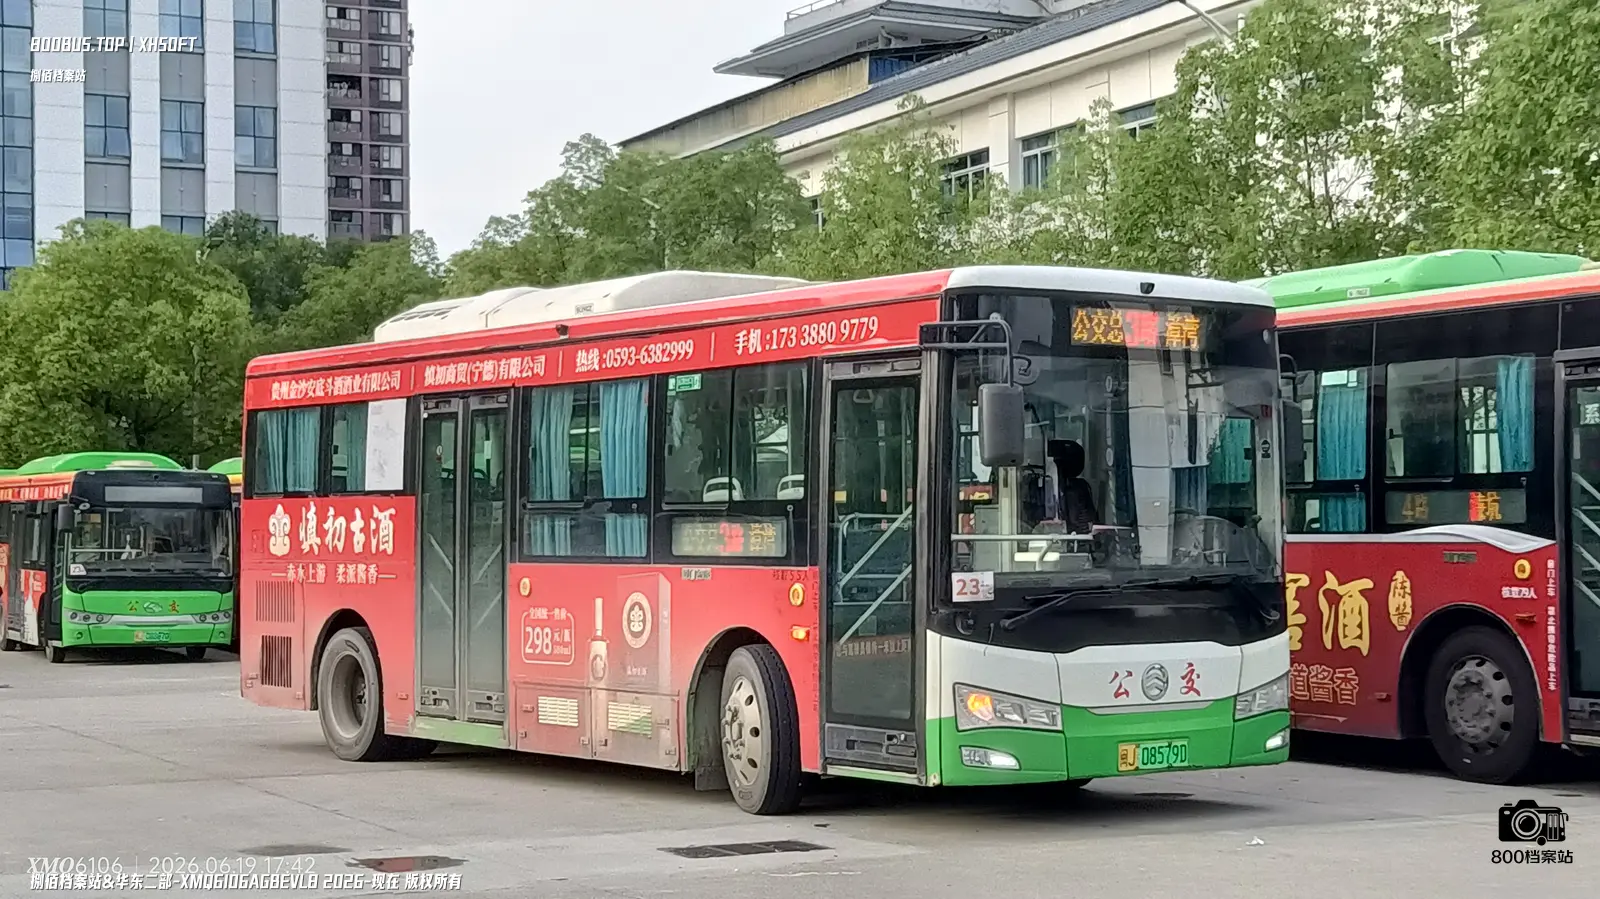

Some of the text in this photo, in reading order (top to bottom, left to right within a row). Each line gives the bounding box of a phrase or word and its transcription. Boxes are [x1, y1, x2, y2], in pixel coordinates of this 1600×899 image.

[800, 320, 836, 345] 3880
[840, 315, 879, 340] 9779
[286, 563, 379, 585] 赤水上游 柔派酱香
[956, 578, 980, 596] 23
[525, 626, 552, 655] 298
[1109, 662, 1201, 699] 公 交
